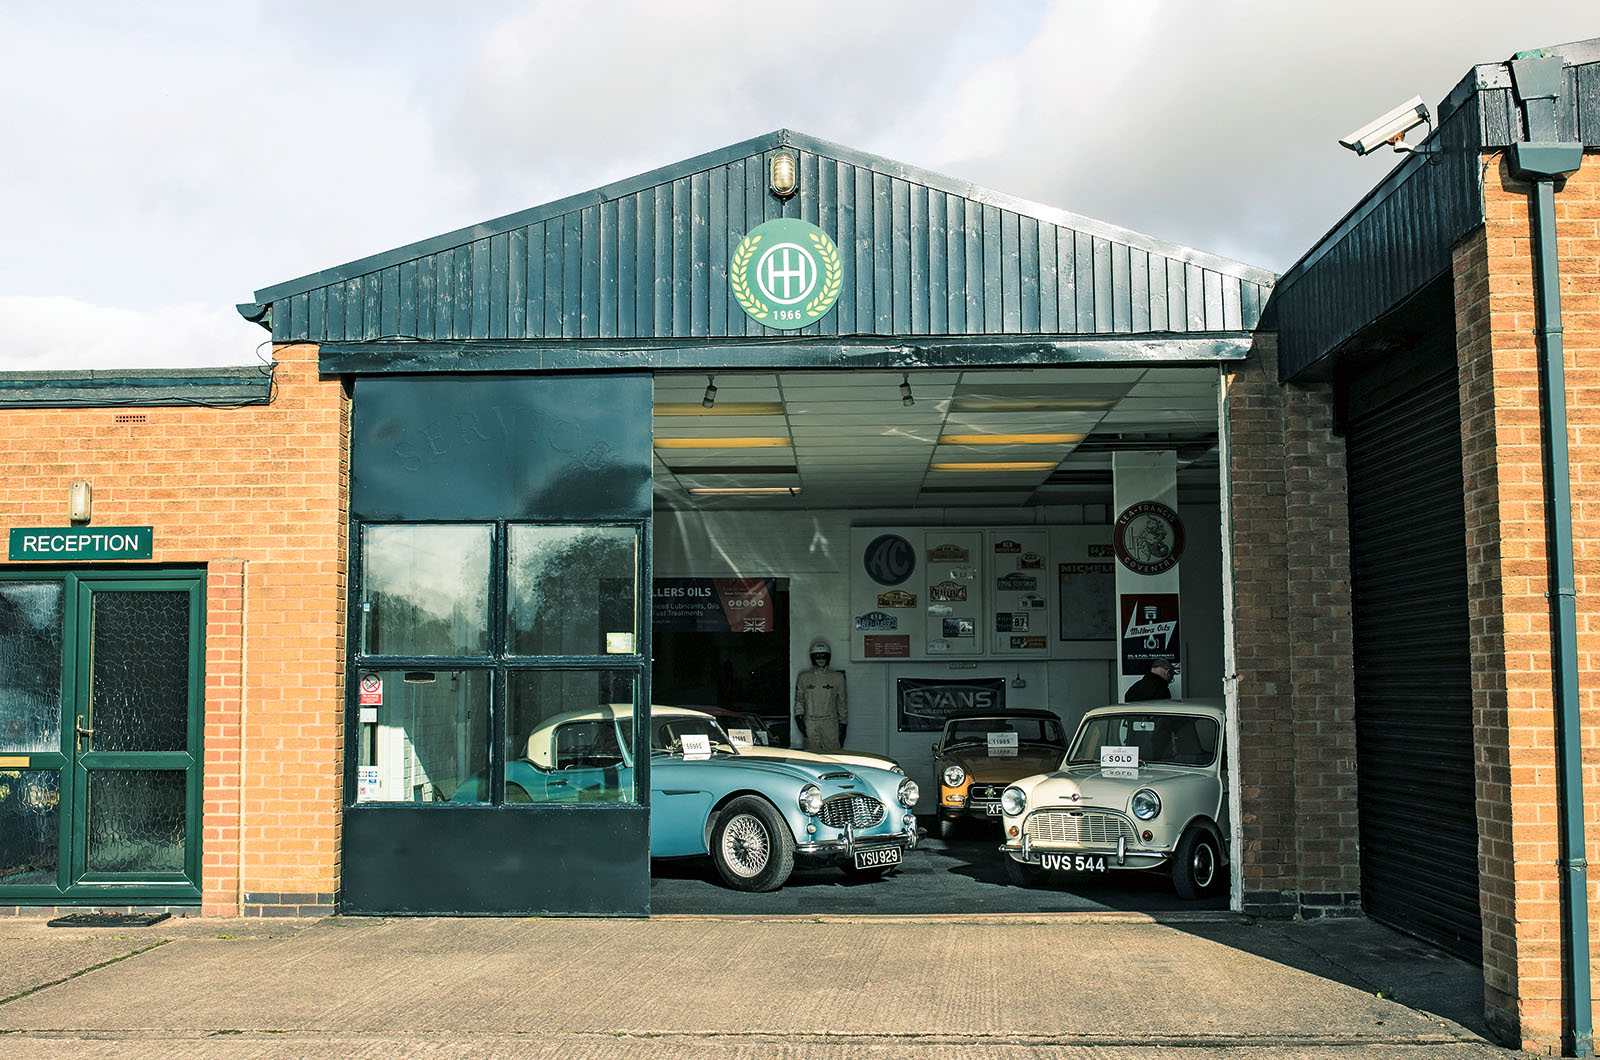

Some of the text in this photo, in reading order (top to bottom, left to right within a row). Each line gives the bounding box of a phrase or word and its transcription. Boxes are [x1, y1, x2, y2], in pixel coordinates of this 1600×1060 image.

[773, 310, 801, 320] 1966
[1119, 504, 1176, 525] LEA-FRANCIS
[23, 534, 139, 552] RECEPTION
[868, 538, 911, 580] AC
[1123, 555, 1177, 573] COVENTRY
[1060, 564, 1113, 573] MICHELI
[687, 587, 712, 597] OILS
[1014, 618, 1025, 627] 87
[1130, 624, 1171, 636] Millers Oils
[910, 691, 992, 708] EVANS
[1108, 755, 1132, 763] SOLD
[1041, 854, 1106, 873] UVS 544
